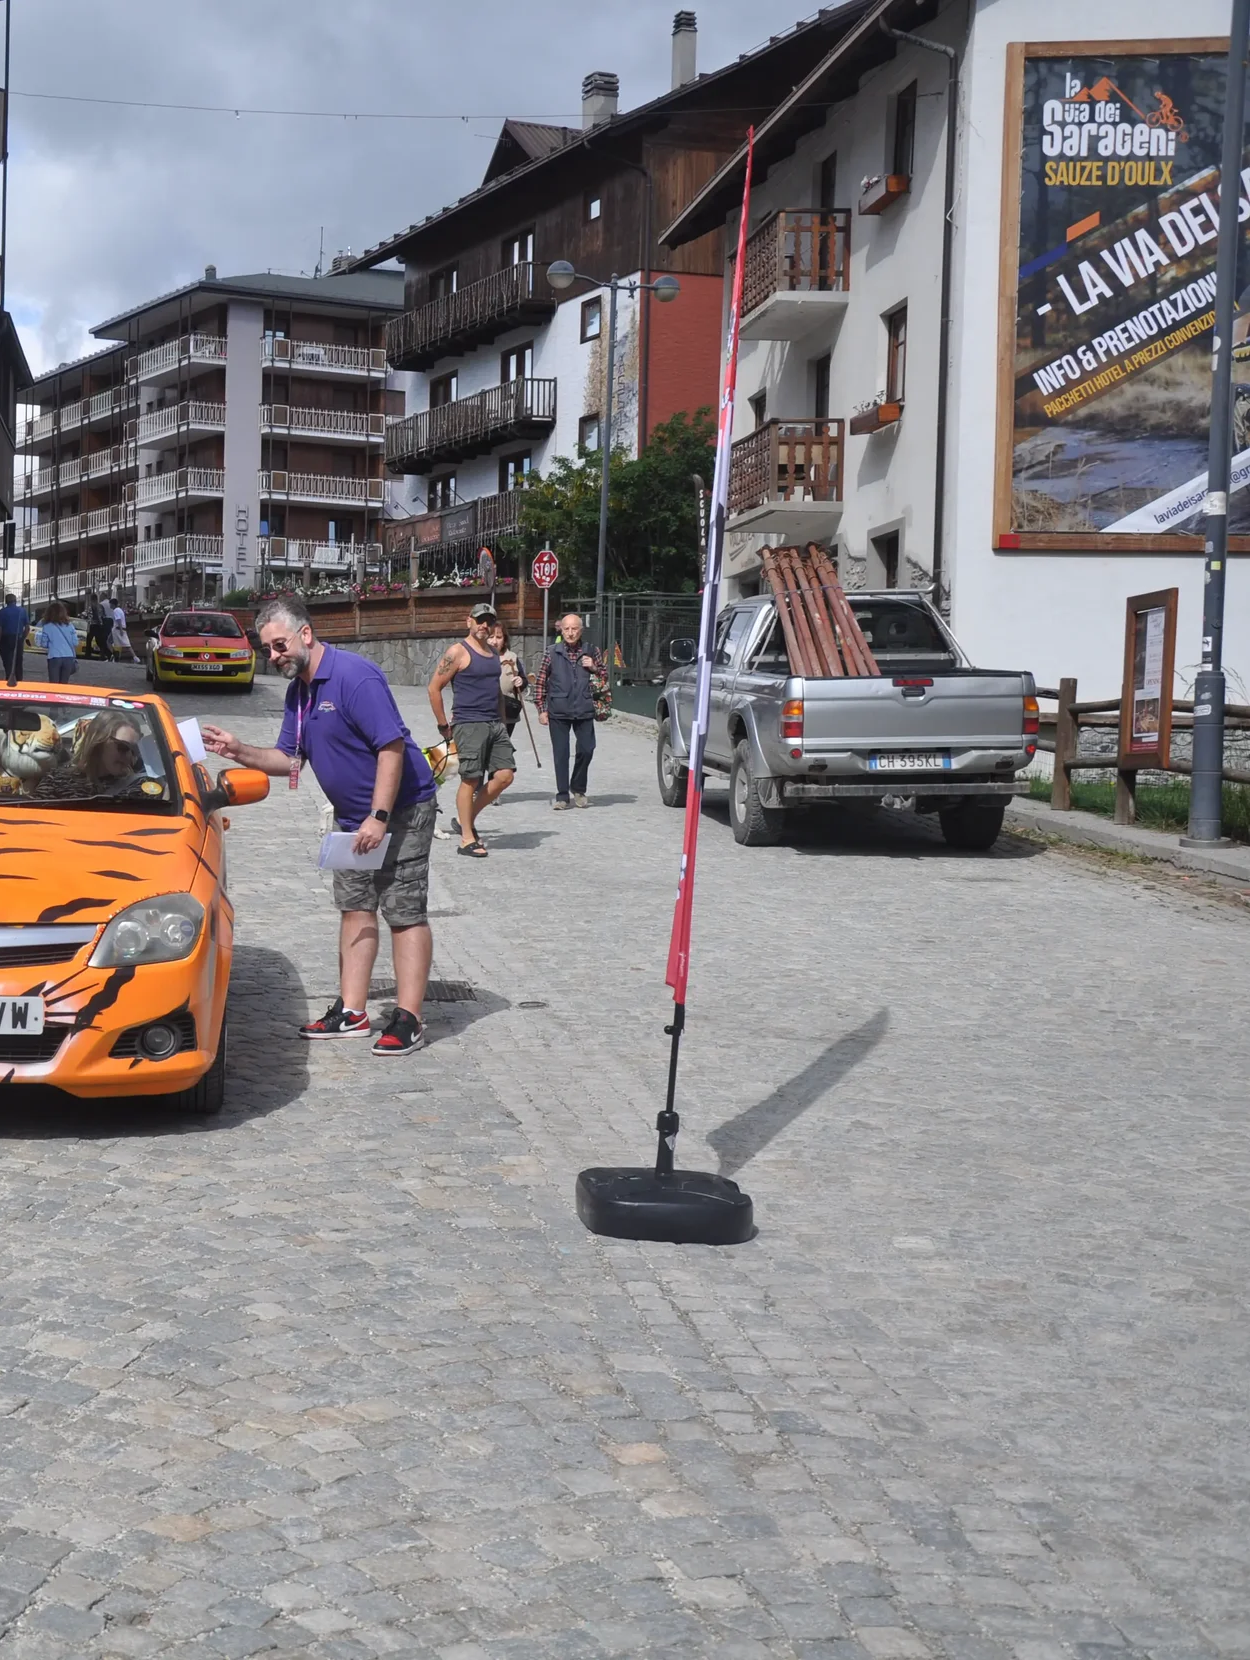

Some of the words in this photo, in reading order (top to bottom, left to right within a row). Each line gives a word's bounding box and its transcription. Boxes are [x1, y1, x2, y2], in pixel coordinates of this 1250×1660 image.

[1065, 72, 1081, 99] la
[1064, 103, 1090, 123] via
[1094, 101, 1121, 123] dei
[1044, 161, 1103, 186] SAUZE
[1107, 160, 1174, 186] D'OULX
[1056, 260, 1114, 316] LA
[1099, 228, 1171, 289] VIA
[1158, 192, 1220, 258] DEI
[1033, 354, 1082, 396] INFO
[1077, 345, 1098, 371] &
[1043, 380, 1097, 418] PACCHETTI
[1093, 364, 1127, 390] HOTEL
[1124, 359, 1135, 373] A
[1131, 340, 1168, 369] PREZZI
[236, 504, 249, 575] HOTEL
[534, 562, 556, 576] STOP
[878, 755, 895, 768] CH
[899, 754, 941, 768] 395KL
